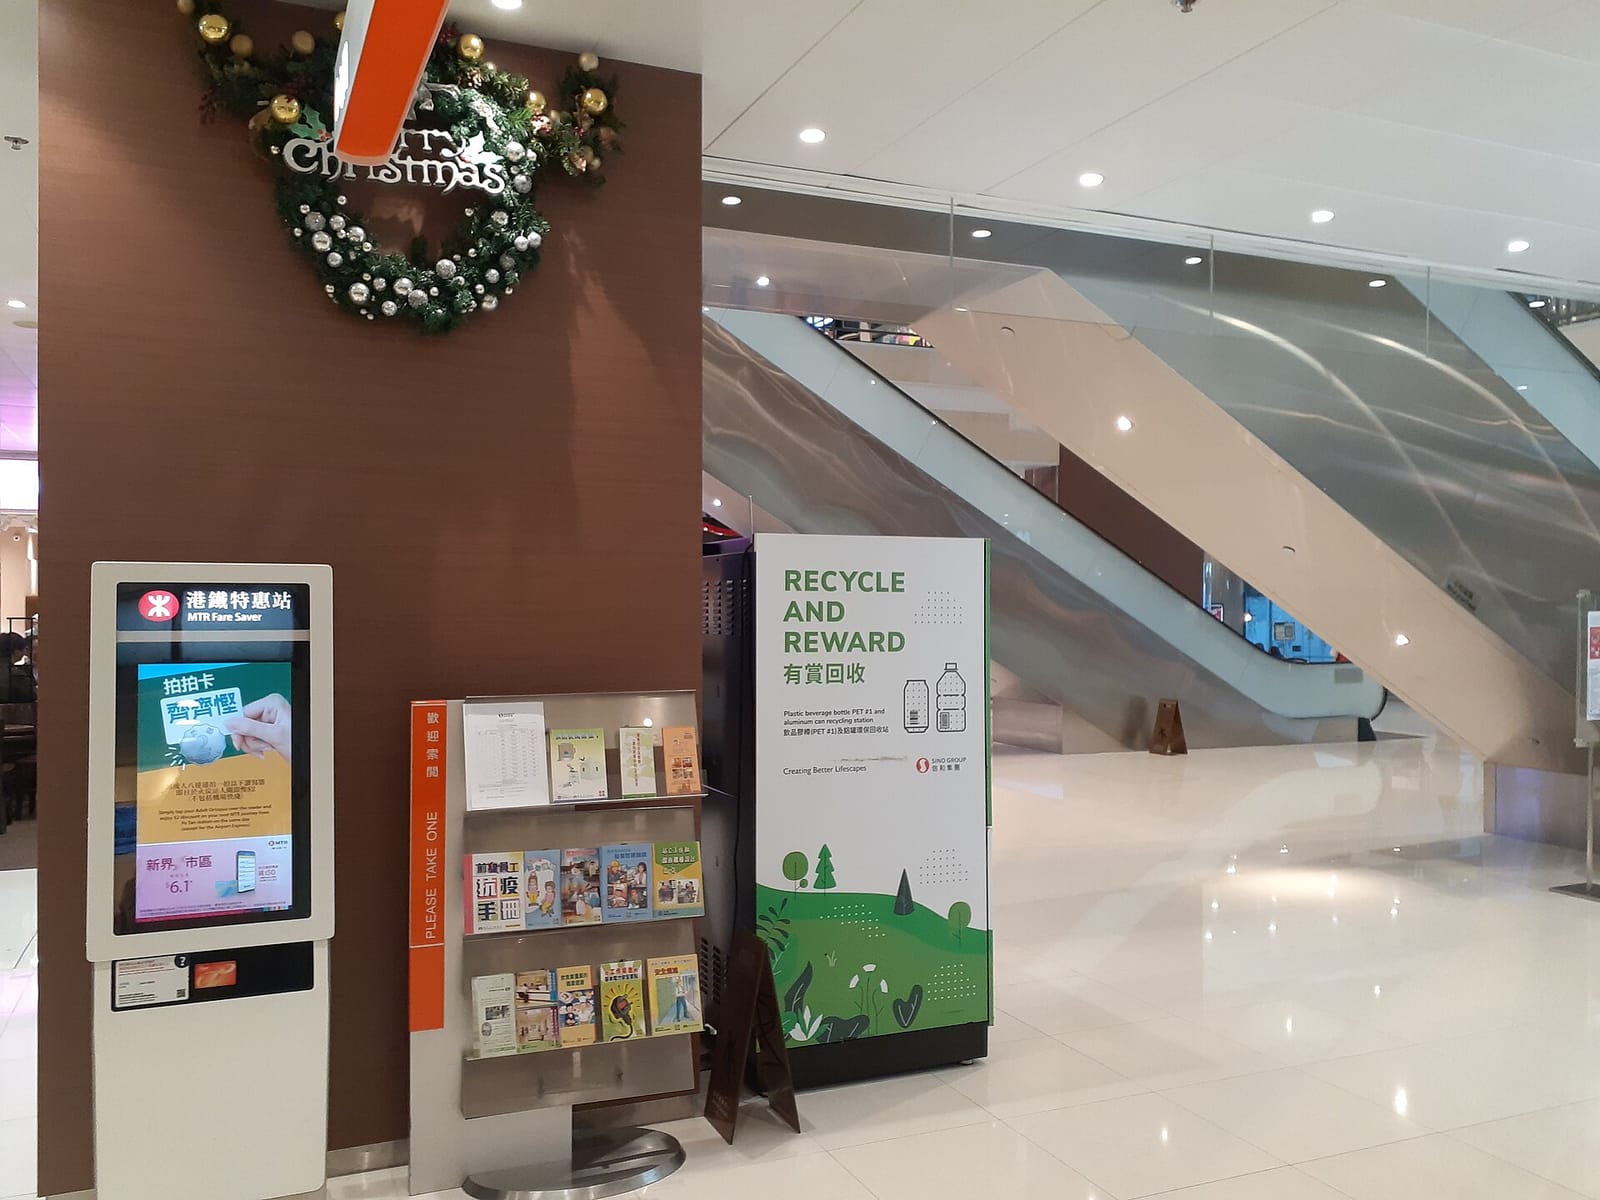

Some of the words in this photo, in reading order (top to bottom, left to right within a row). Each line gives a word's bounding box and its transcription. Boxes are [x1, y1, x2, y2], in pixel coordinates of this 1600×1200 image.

[784, 570, 905, 592] RECYCLE
[186, 591, 292, 610] 港鐵特惠站
[187, 612, 211, 622] MTR
[212, 612, 233, 622] Fare
[234, 612, 263, 622] Saver
[783, 601, 845, 622] AND
[784, 631, 906, 653] REWARD
[163, 673, 215, 695] 拍拍卡
[783, 663, 866, 684] 有賞回收
[826, 717, 853, 725] recycling
[783, 767, 812, 775] Creating
[812, 766, 834, 774] Better
[834, 765, 867, 773] Lifescapes
[947, 756, 967, 764] GROUP
[426, 811, 438, 841] ONE
[146, 857, 174, 871] 新界
[185, 855, 213, 868] 市區
[426, 847, 437, 882] TAKE
[425, 888, 437, 939] PLEASE
